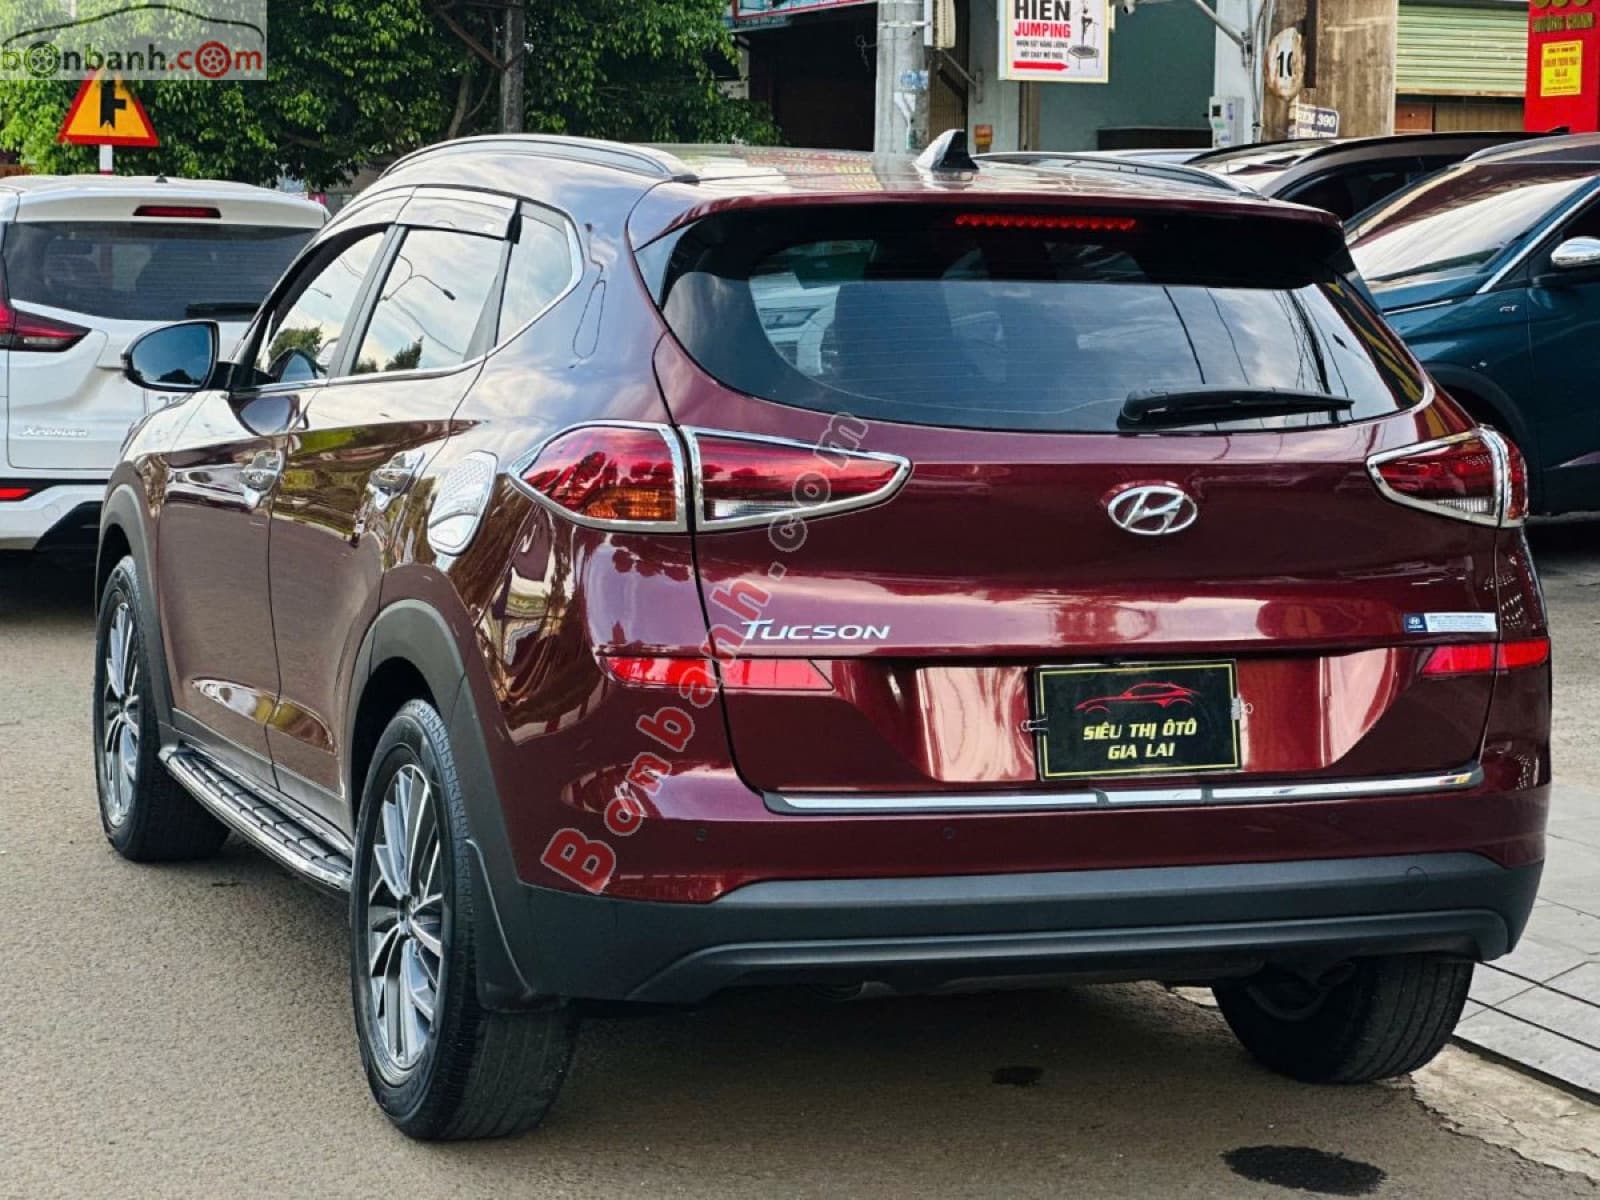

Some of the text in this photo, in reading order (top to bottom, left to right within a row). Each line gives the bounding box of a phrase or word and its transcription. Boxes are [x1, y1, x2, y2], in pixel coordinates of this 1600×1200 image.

[1014, 22, 1071, 38] JUMPING
[741, 619, 890, 640] TUCSON
[1083, 717, 1197, 740] SIÊU THỊ ÔTÔ
[1108, 742, 1175, 760] GIA LAI
